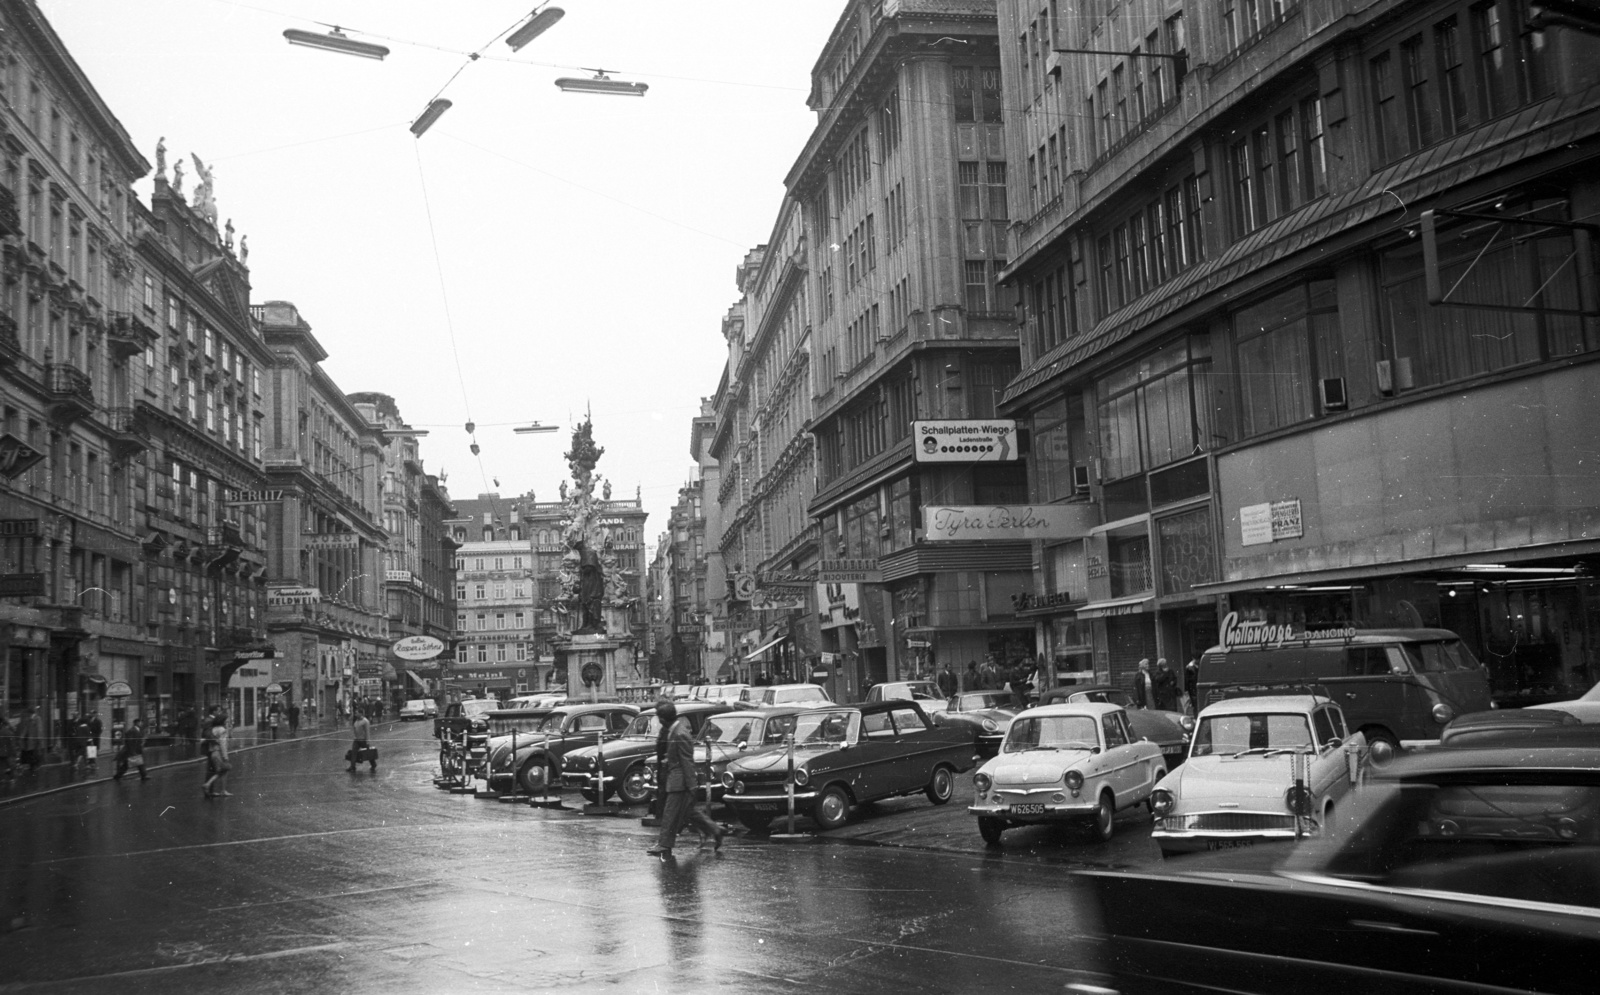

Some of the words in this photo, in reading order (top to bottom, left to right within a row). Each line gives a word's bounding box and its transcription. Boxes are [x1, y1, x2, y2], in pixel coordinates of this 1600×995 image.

[922, 426, 1010, 436] Schallplatten-Wiege
[229, 489, 284, 501] BERLITZ
[936, 508, 985, 537] Tyra
[823, 573, 867, 581] BIJOUTERIE
[268, 597, 321, 606] HELDWEIN
[1219, 611, 1296, 654] Chattanooga
[1304, 627, 1357, 640] DANCING
